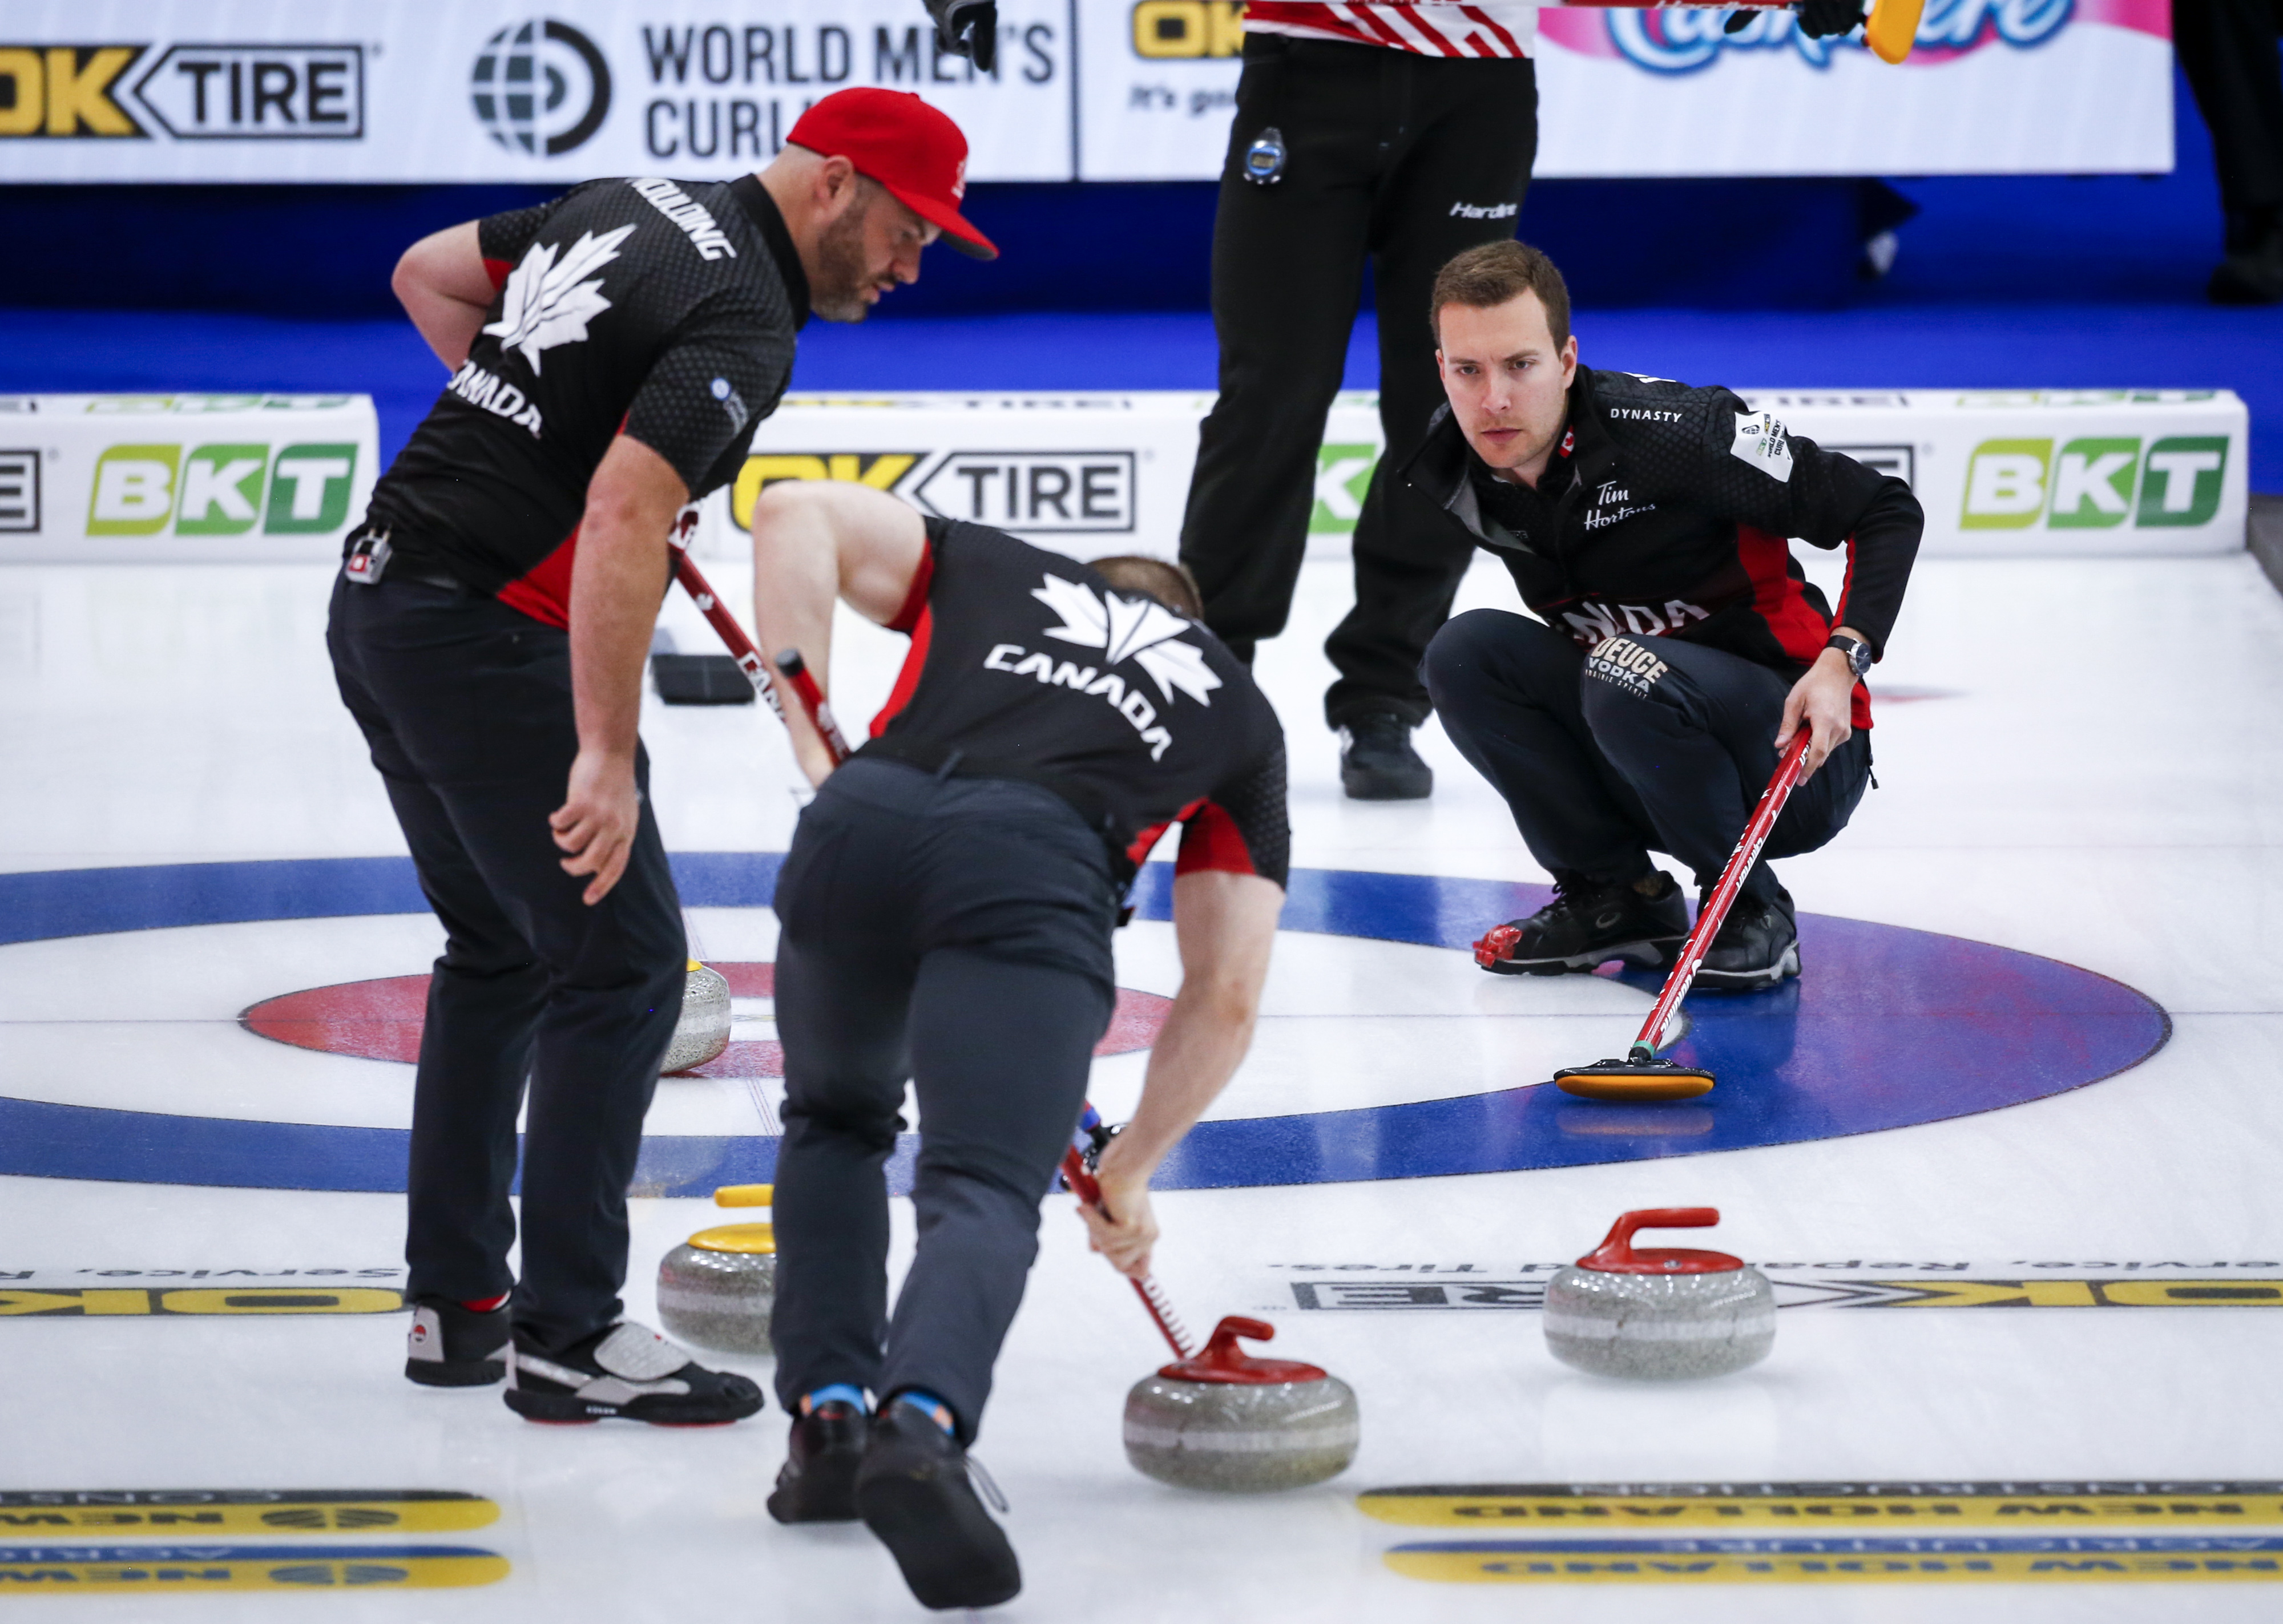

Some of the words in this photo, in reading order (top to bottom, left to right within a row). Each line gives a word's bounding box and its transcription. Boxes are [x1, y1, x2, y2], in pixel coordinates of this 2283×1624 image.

[643, 25, 850, 84] WORLD
[178, 62, 348, 123] TIRE
[447, 360, 542, 439] ANADA
[1610, 408, 1682, 422] DYNASTY
[94, 459, 350, 520] BKT
[957, 465, 1122, 519] TIRE
[1597, 480, 1629, 506] Tim
[1967, 450, 2221, 515] BKT
[1584, 502, 1656, 531] Hortons
[1589, 657, 1650, 693] VODKA
[1591, 637, 1668, 684] DEUCE
[984, 643, 1173, 763] CANADA
[2012, 1261, 2282, 1271] ervice,
[1996, 1505, 2244, 1516] NEW
